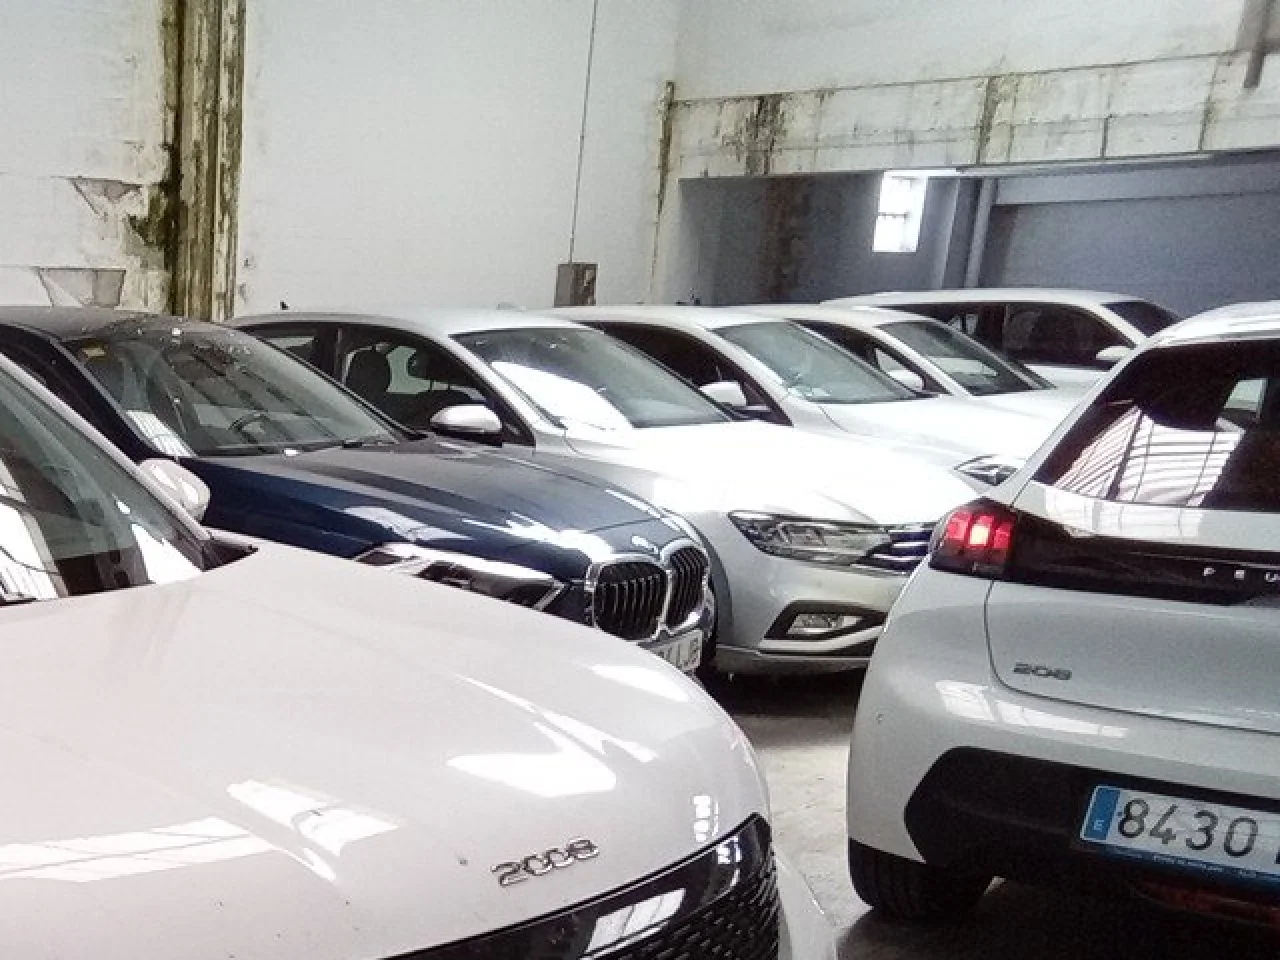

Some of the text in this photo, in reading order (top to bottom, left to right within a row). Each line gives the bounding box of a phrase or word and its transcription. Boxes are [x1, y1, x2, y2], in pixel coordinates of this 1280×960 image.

[1013, 662, 1072, 681] 208
[1117, 797, 1259, 858] 8430
[490, 836, 600, 887] 2008
